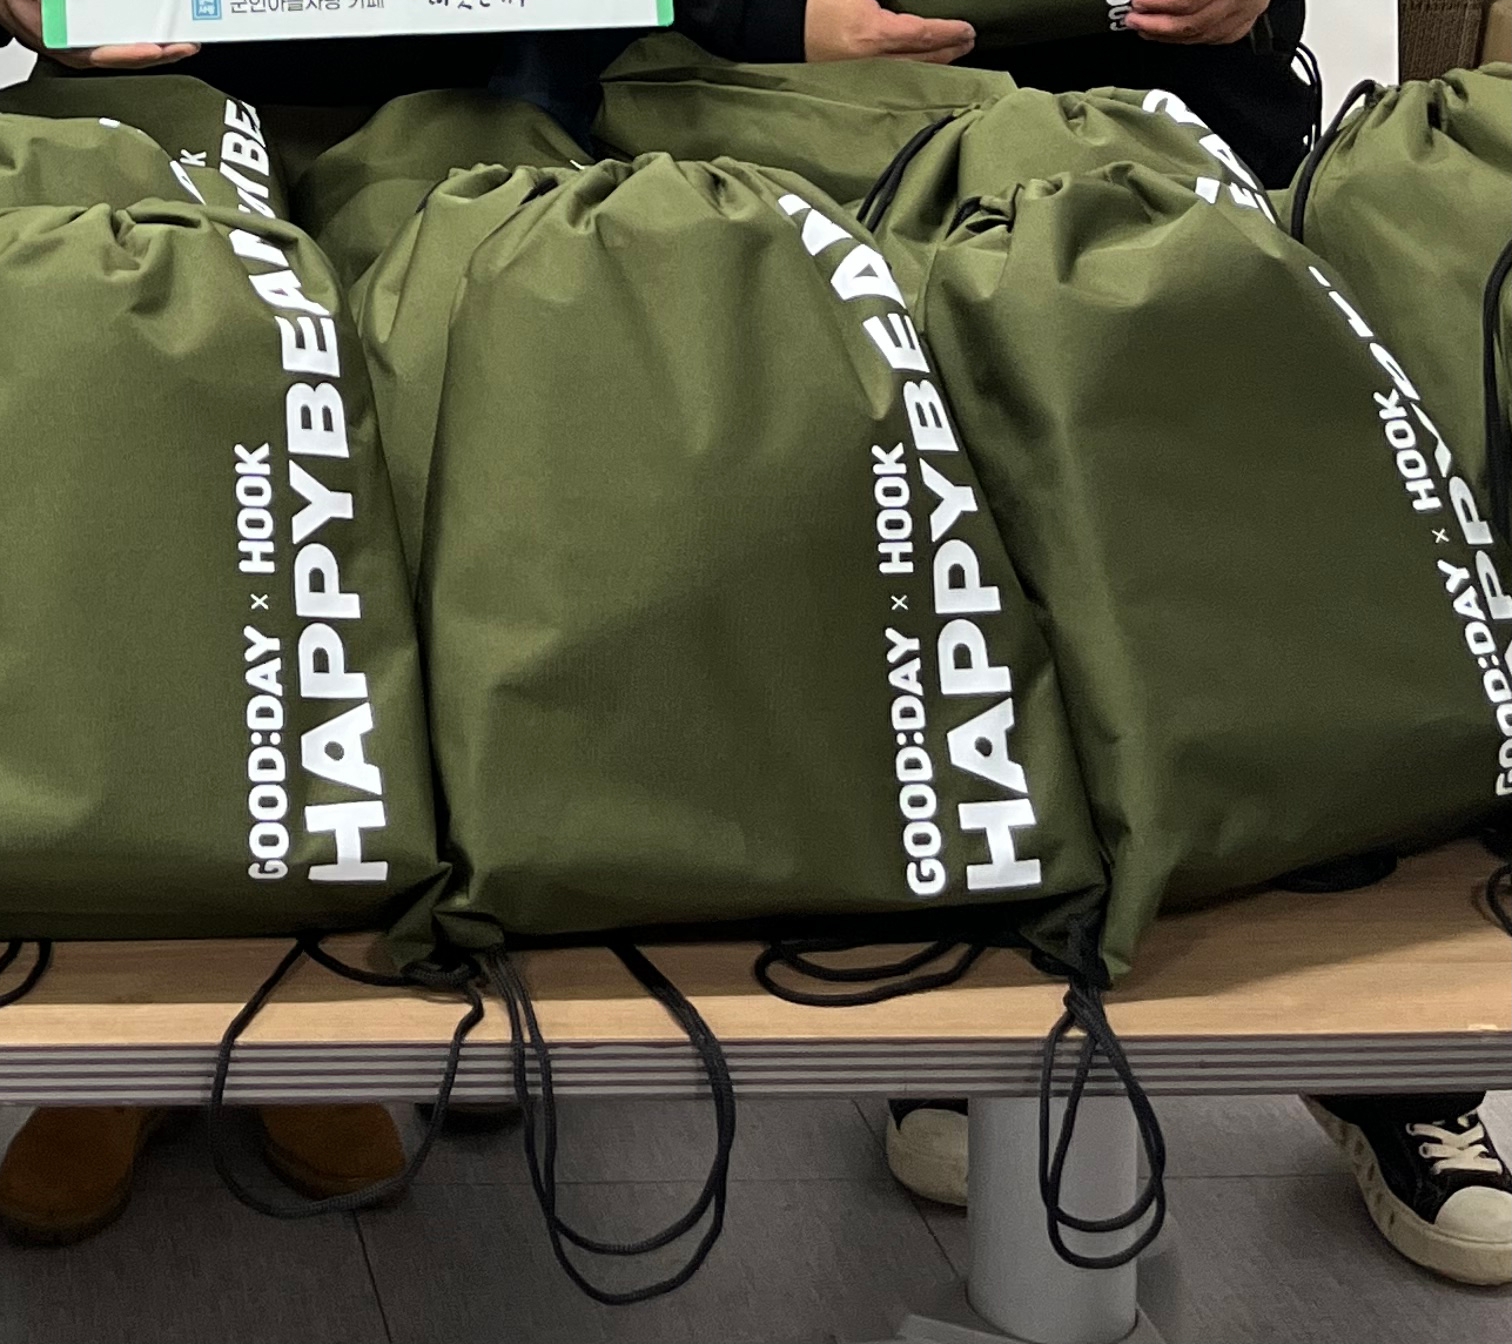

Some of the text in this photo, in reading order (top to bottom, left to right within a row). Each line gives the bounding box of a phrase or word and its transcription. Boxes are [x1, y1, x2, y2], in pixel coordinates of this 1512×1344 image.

[233, 442, 276, 574] HOOK
[871, 442, 915, 576] HOOK
[1373, 389, 1442, 512] HOOK
[779, 193, 1041, 892] HAPPYBEAN
[889, 625, 947, 897] GOOD:DAY
